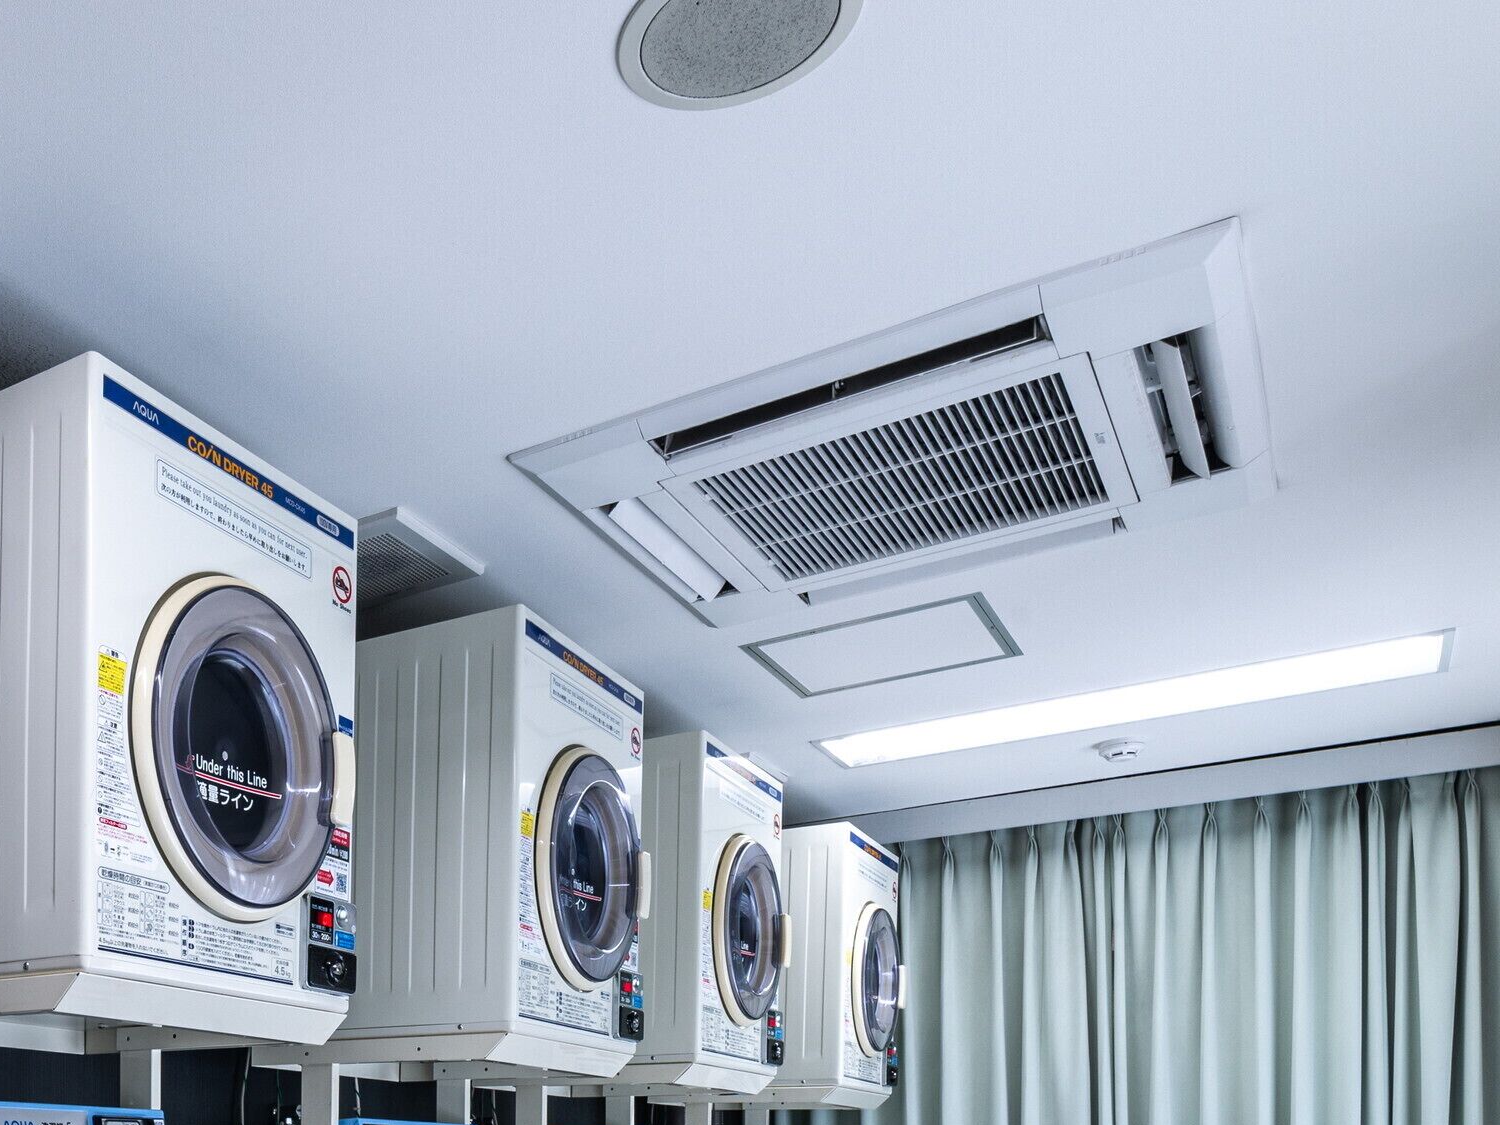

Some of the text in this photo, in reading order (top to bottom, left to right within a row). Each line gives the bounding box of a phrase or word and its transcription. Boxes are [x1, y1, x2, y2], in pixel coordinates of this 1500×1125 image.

[132, 401, 160, 425] AQUA
[162, 466, 179, 485] Please
[180, 479, 192, 492] take
[223, 457, 260, 491] DRYER
[260, 482, 274, 500] 45
[195, 753, 268, 789] Under this Line
